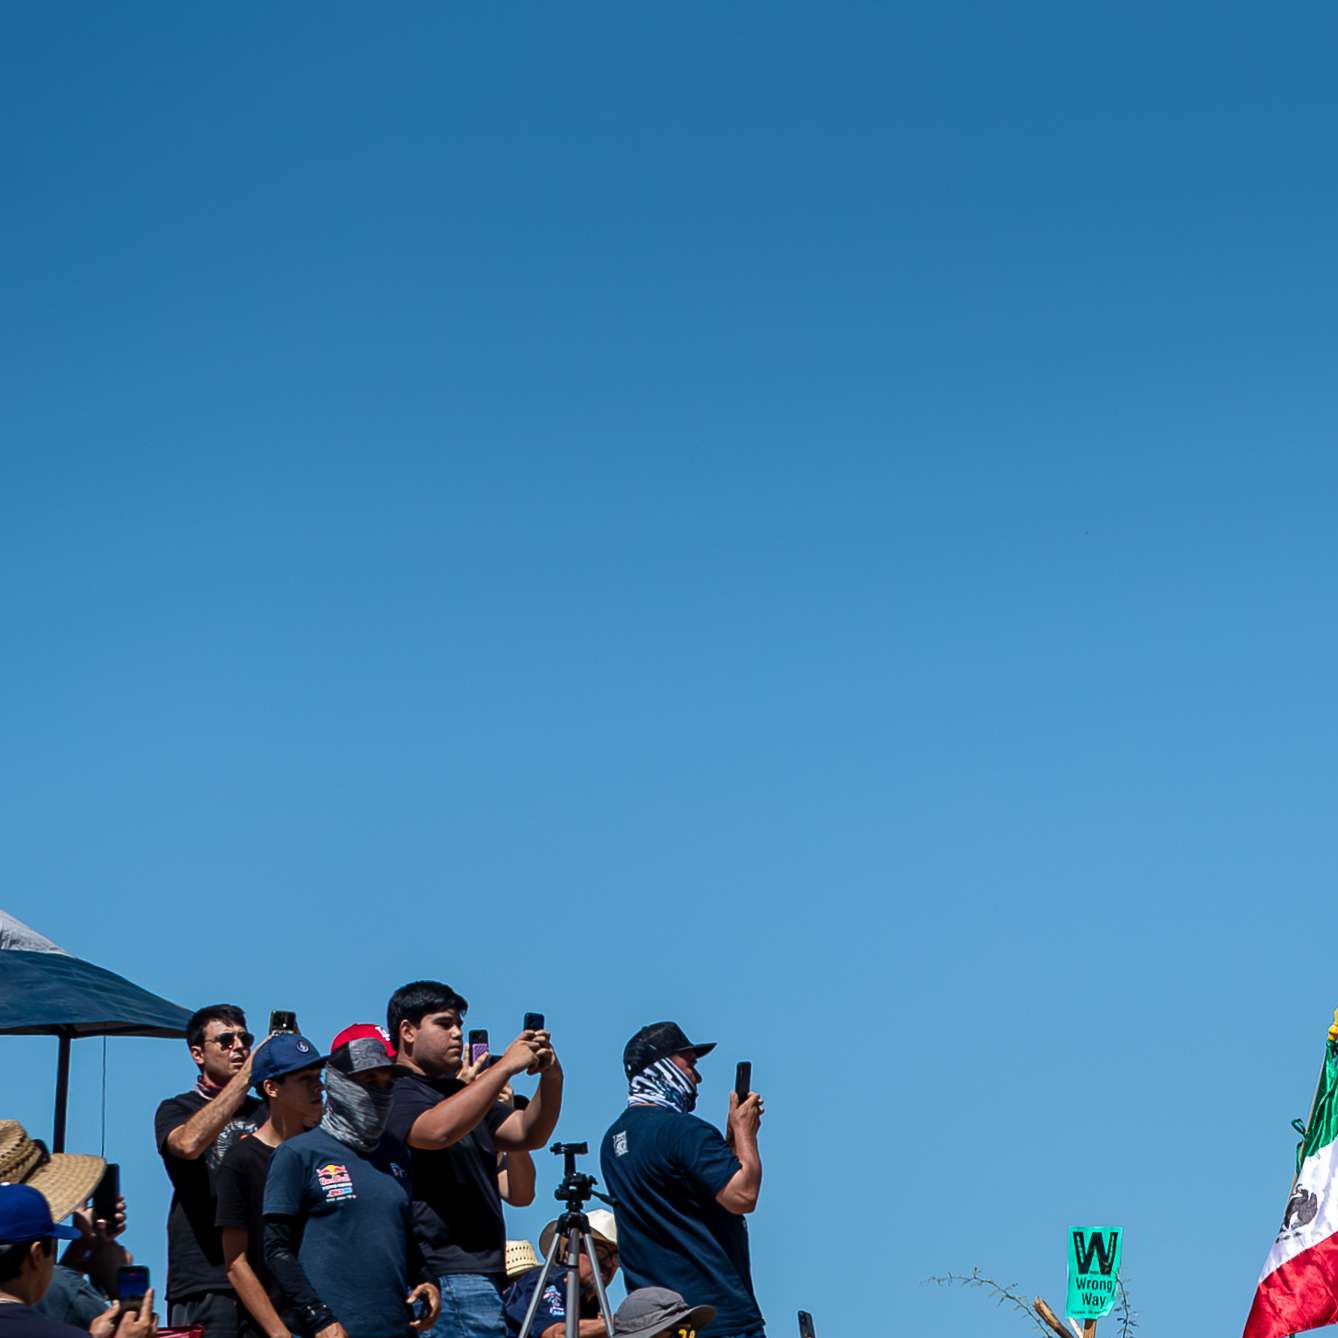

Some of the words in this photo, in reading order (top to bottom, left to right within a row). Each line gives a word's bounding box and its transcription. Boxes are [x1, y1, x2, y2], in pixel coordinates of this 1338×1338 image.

[1072, 1232, 1119, 1275] W
[1076, 1277, 1113, 1293] Wrong
[1082, 1292, 1106, 1308] Way
